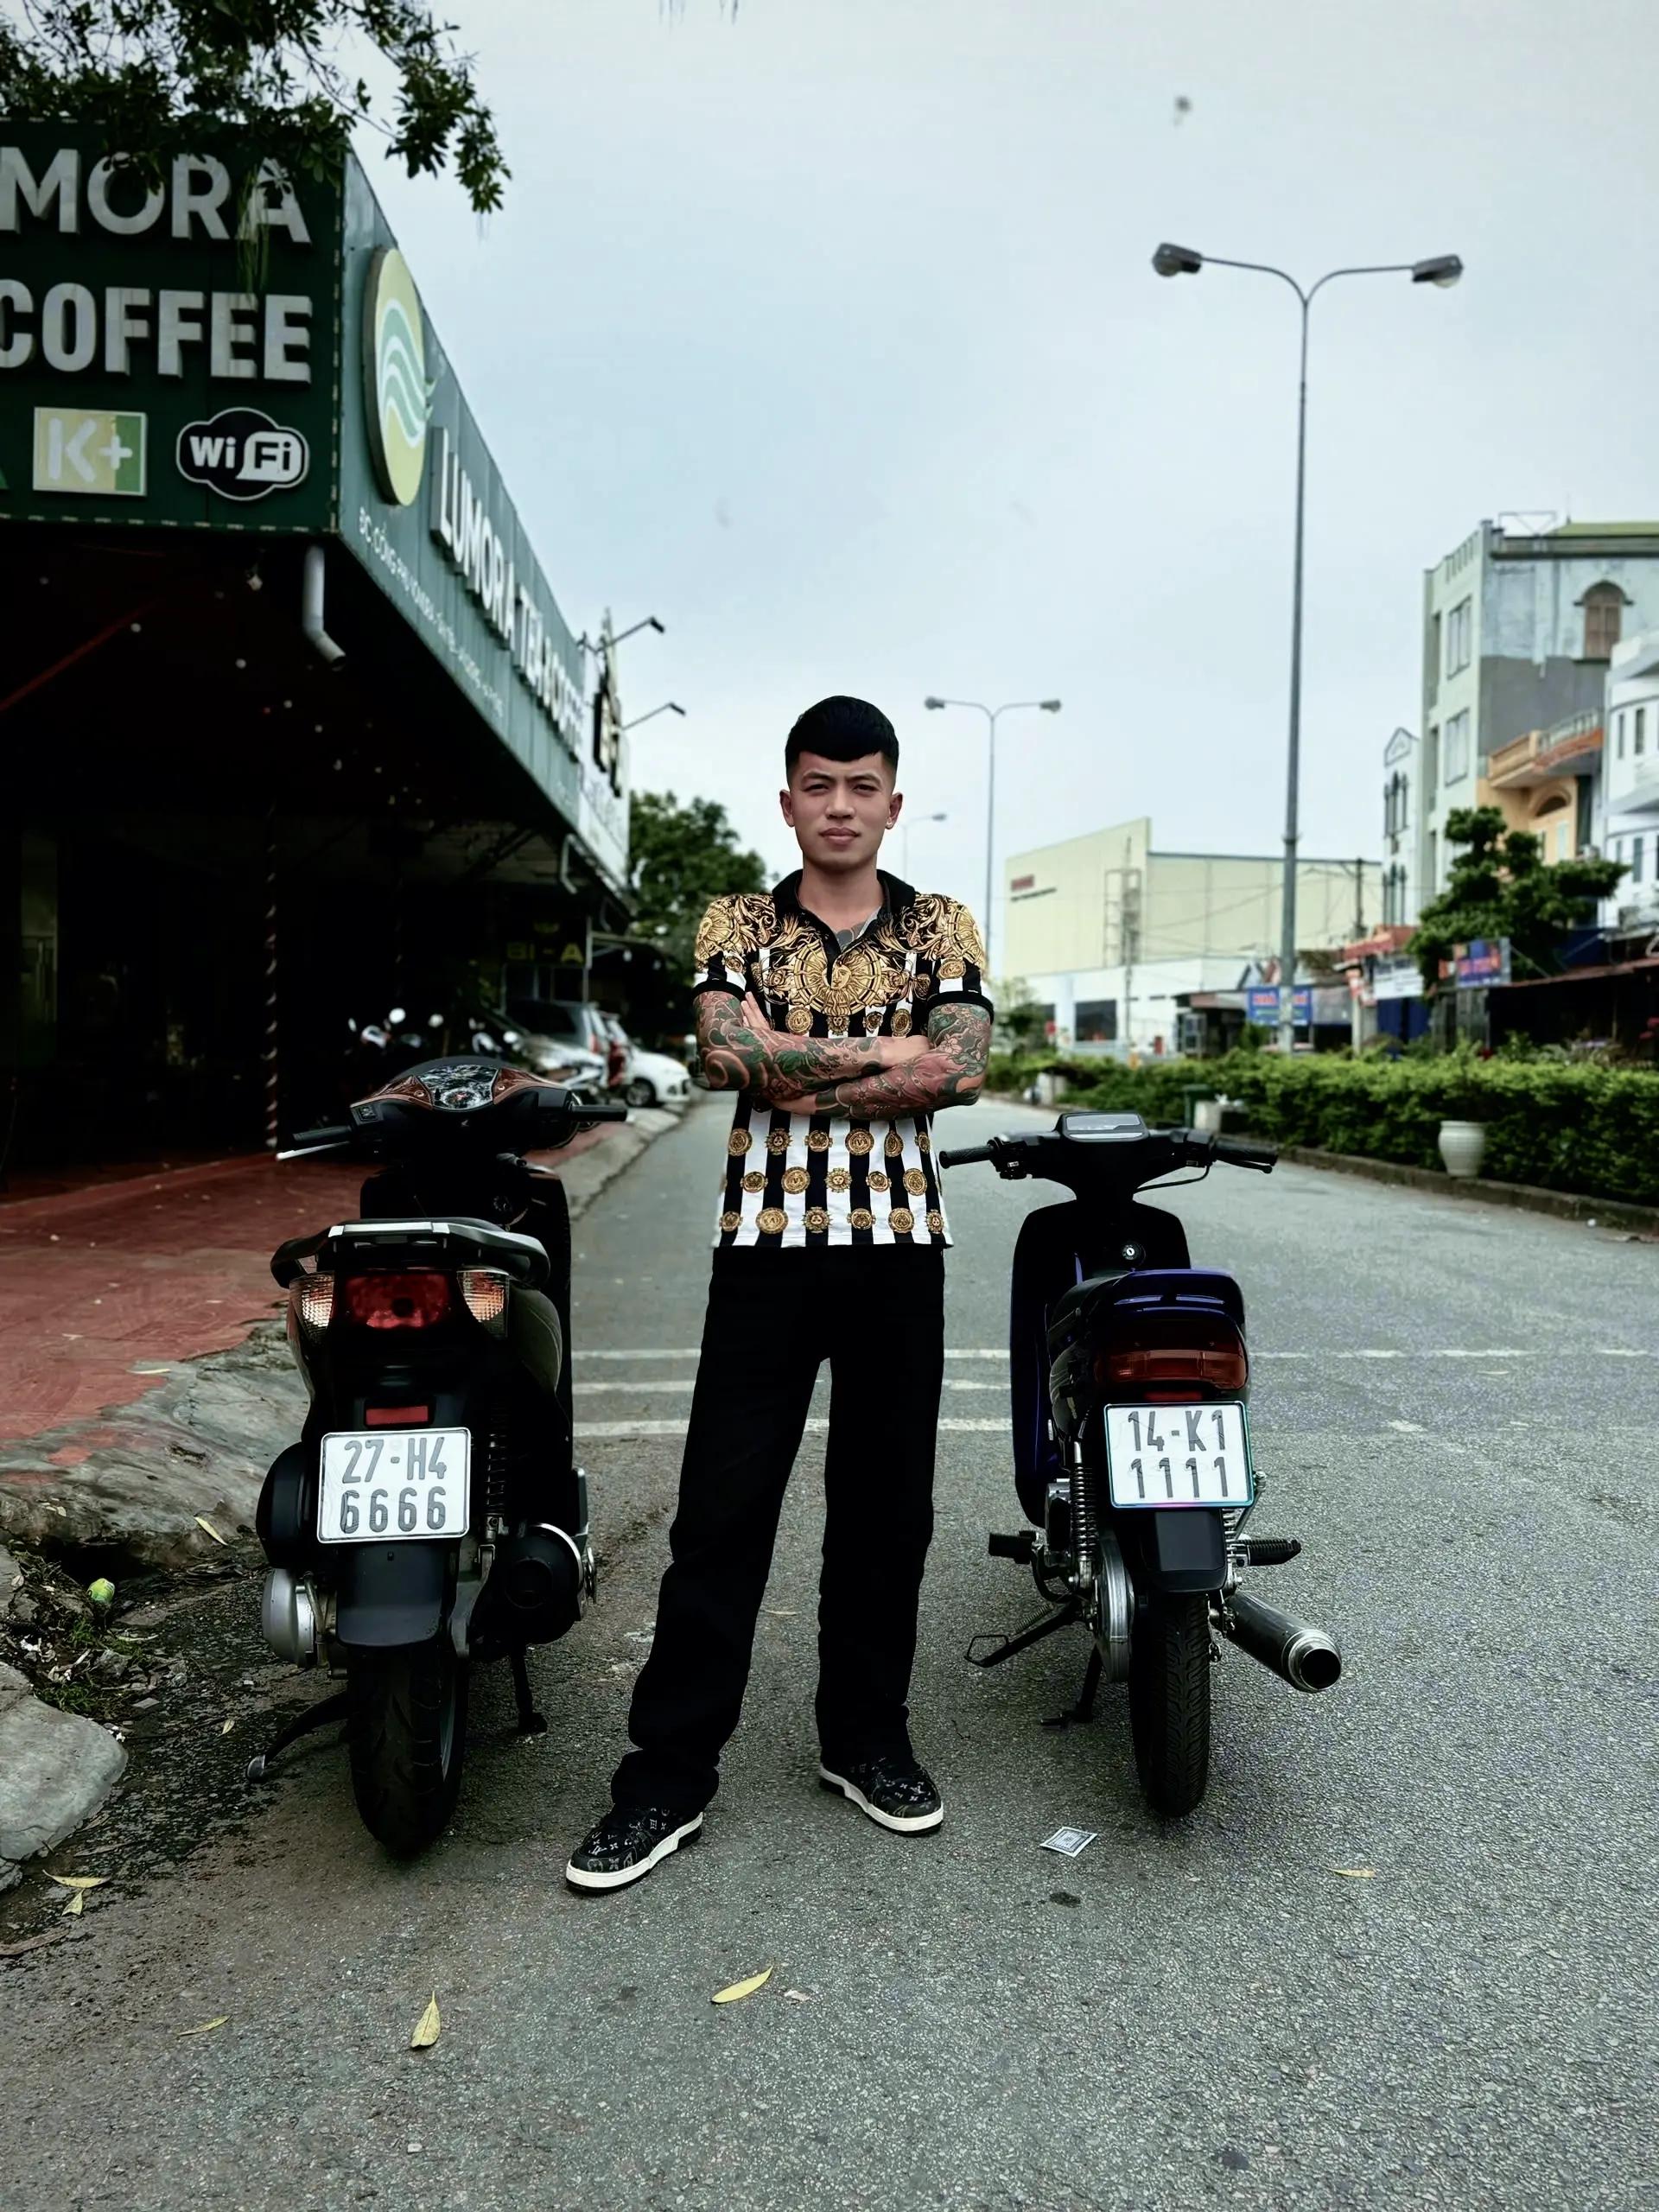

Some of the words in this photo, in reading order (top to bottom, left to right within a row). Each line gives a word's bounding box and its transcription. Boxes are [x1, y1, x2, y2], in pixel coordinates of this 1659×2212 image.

[0, 146, 312, 245] MORA
[0, 279, 312, 383] COFFEE
[48, 417, 133, 483] K+
[440, 428, 516, 652] LUMORA
[1128, 1409, 1225, 1452] 14-K1
[342, 1437, 447, 1484] 27-H4
[1130, 1457, 1228, 1499] 1111
[340, 1486, 446, 1534] 6666
